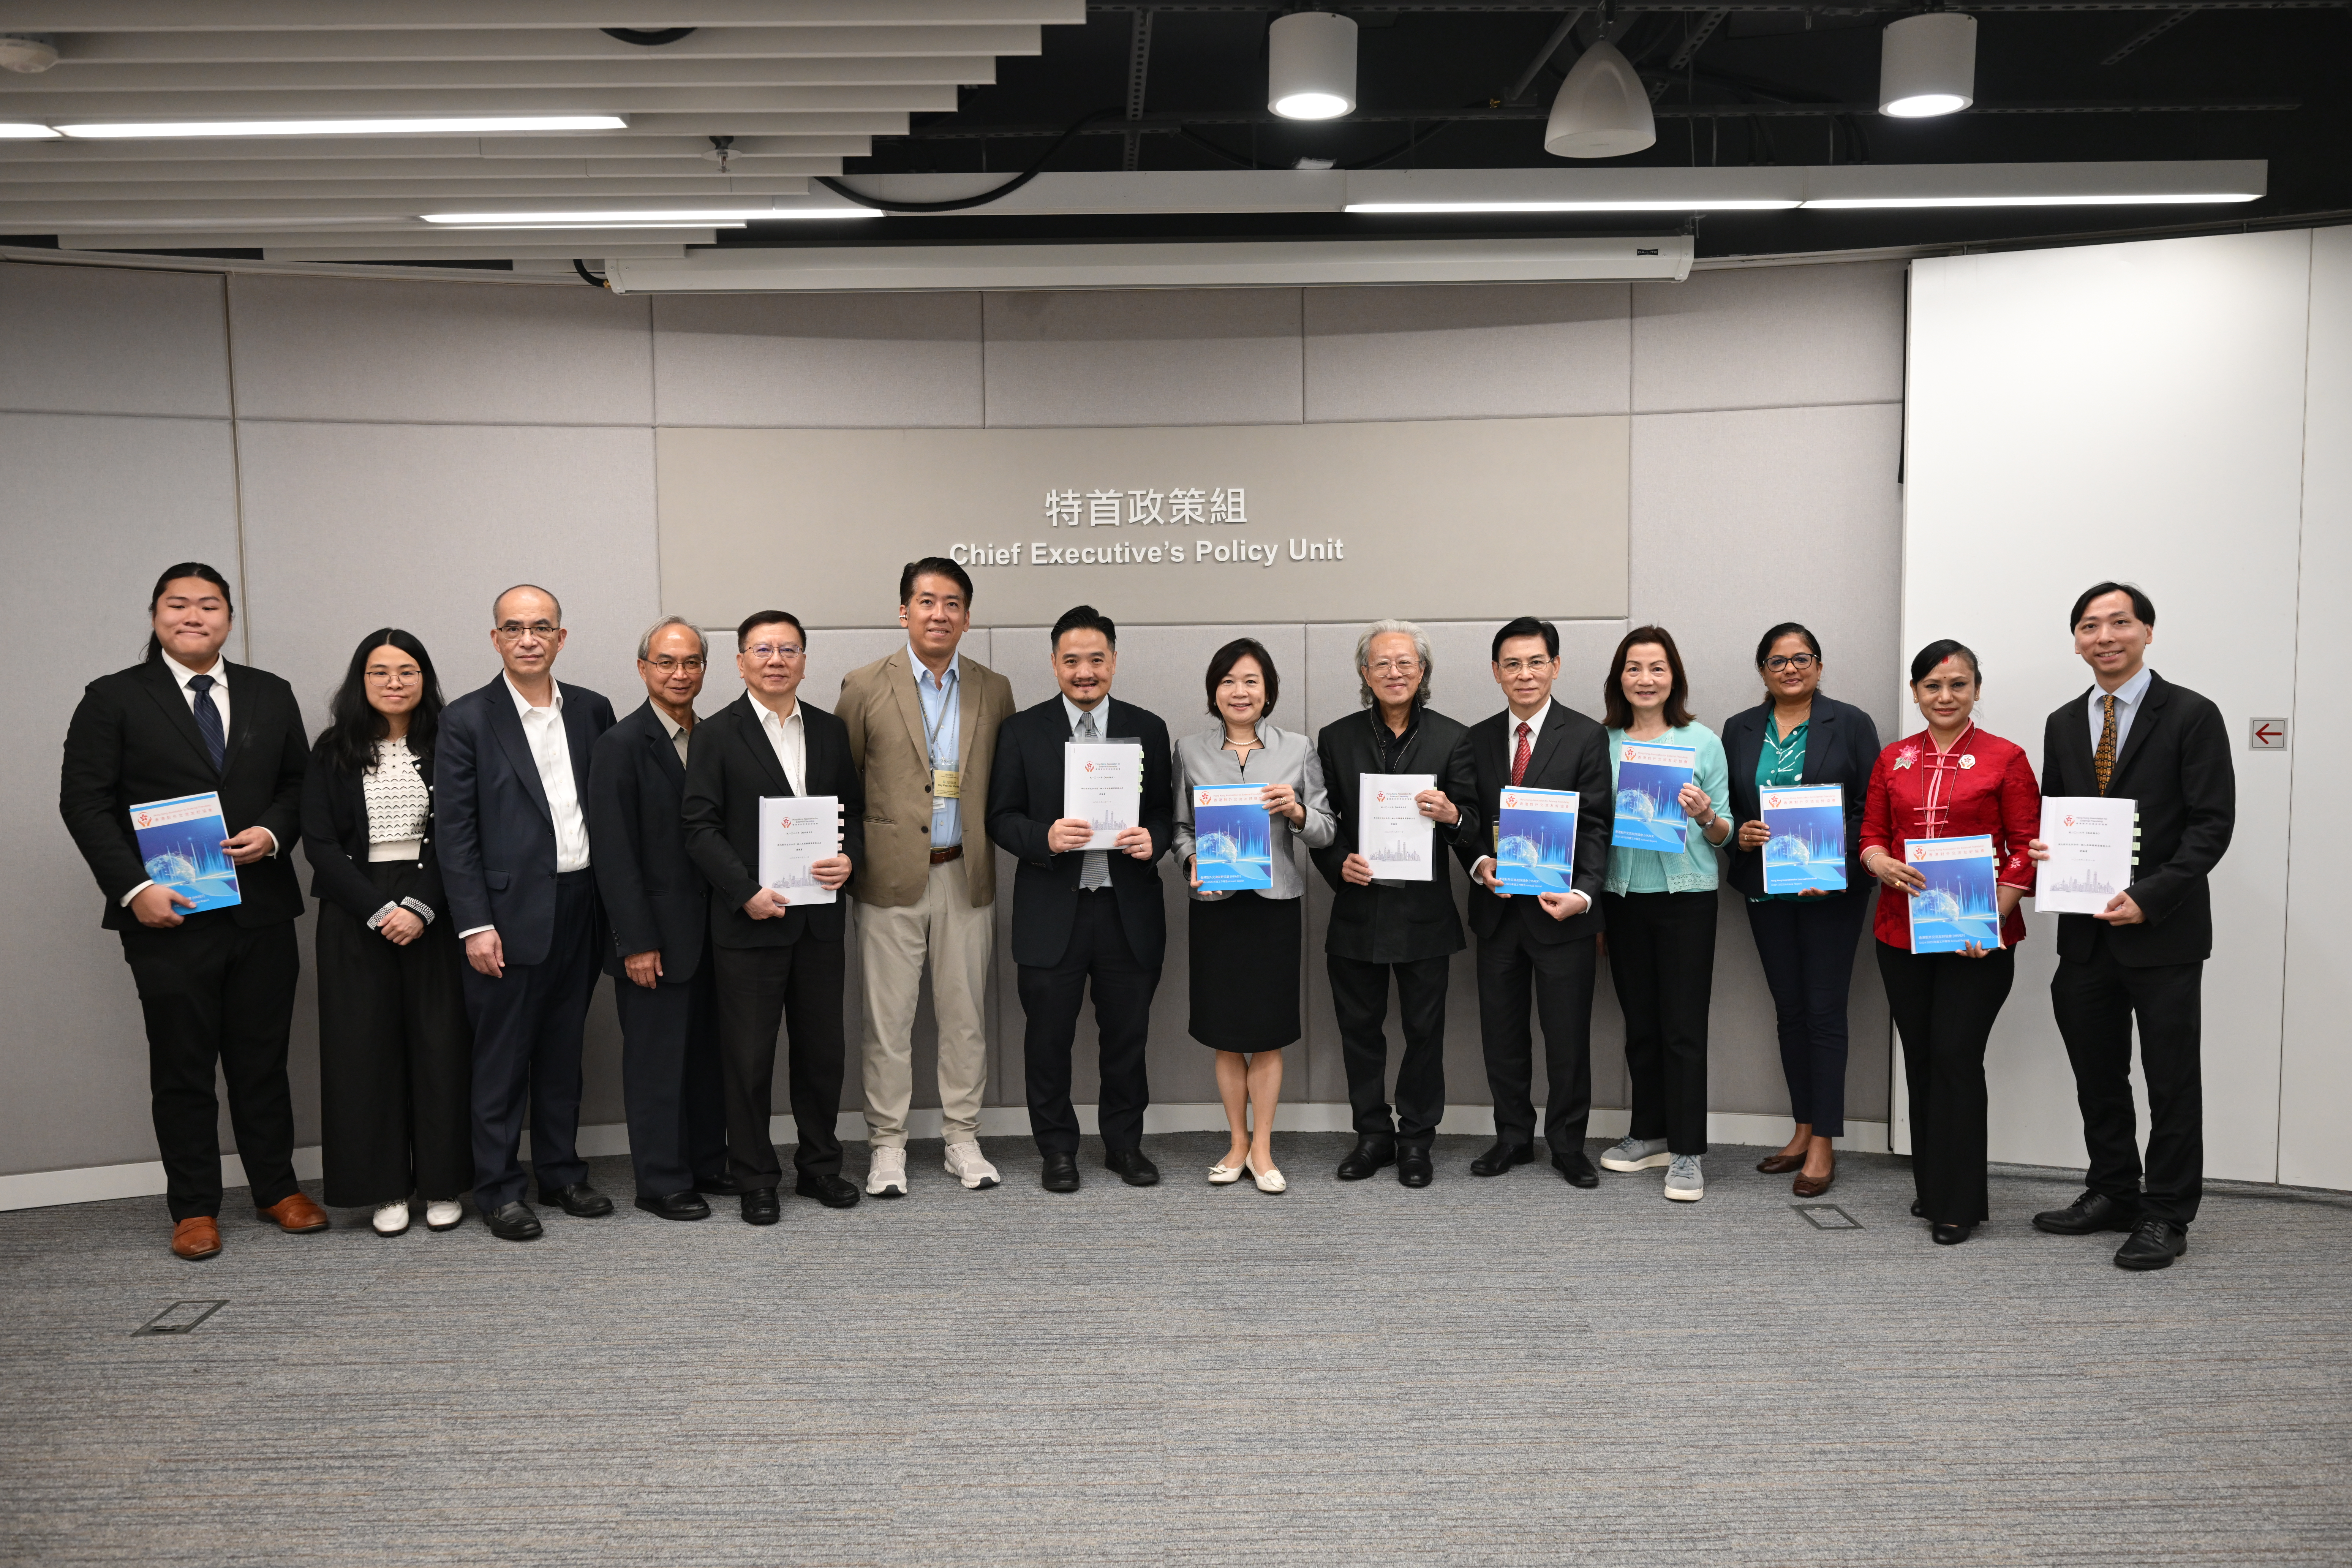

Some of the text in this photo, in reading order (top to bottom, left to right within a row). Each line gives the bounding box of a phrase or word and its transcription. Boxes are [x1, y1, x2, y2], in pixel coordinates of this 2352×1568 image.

[1045, 488, 1247, 526] 特首政策組
[950, 543, 1021, 565] Chief
[1196, 540, 1278, 566] Policy
[1290, 538, 1344, 560] Unit
[1638, 756, 1687, 764] 香港對外交流友好協會
